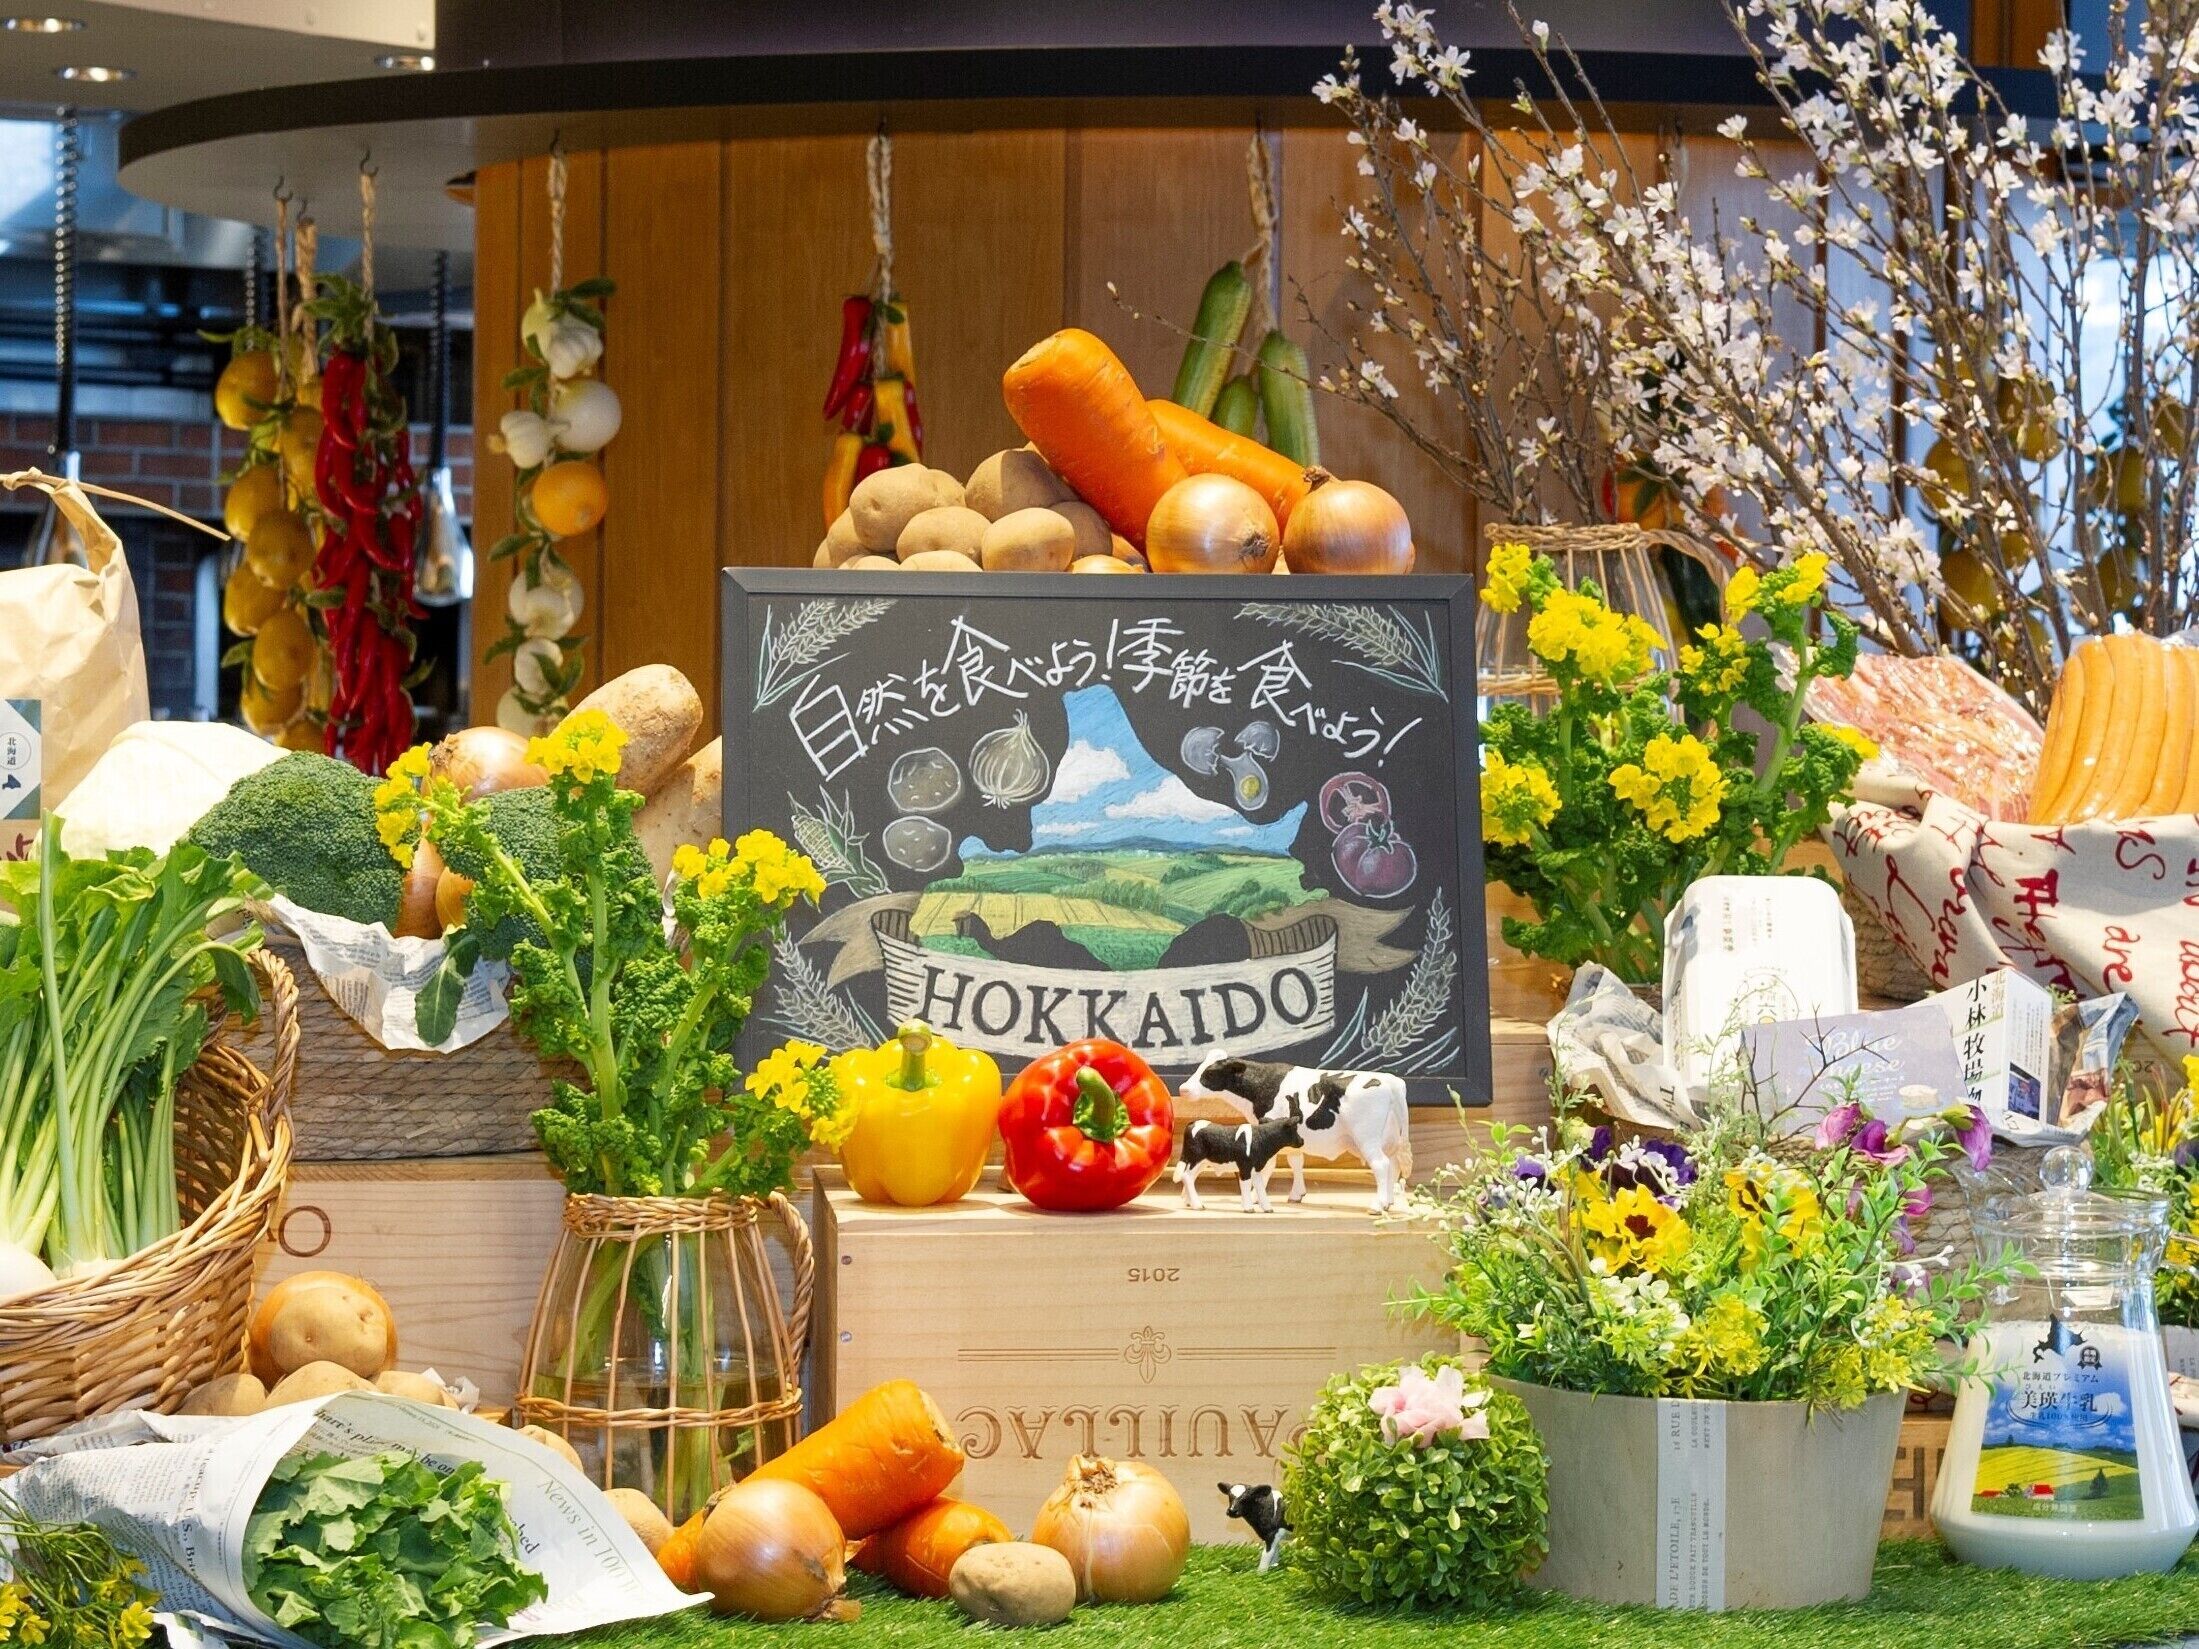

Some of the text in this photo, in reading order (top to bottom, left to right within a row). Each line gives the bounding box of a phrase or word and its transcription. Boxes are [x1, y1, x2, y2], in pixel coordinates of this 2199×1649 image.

[915, 964, 1318, 1049] HOKKAIDO
[1127, 1265, 1180, 1283] 2015
[956, 1405, 1313, 1461] AUILLAC
[538, 1480, 581, 1525] News
[577, 1526, 598, 1547] in
